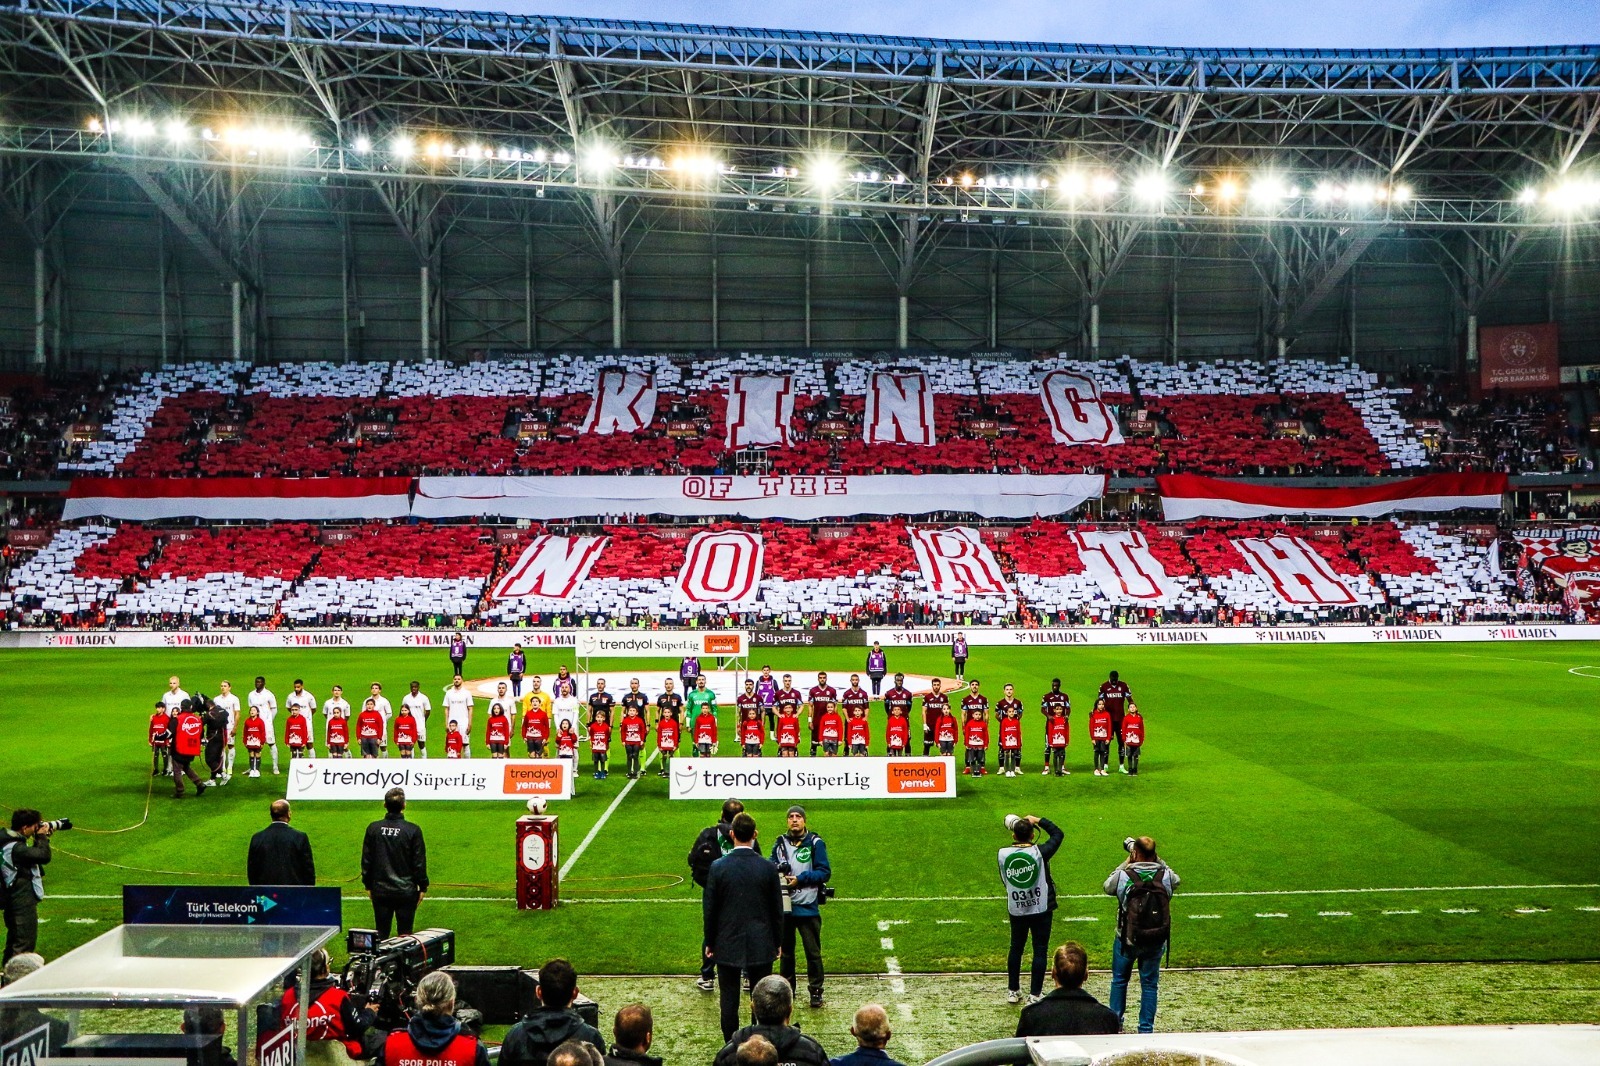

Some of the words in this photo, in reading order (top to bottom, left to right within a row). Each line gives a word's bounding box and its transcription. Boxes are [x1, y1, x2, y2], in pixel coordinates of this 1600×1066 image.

[1506, 367, 1536, 376] GENÇLİK
[1510, 373, 1550, 382] BAKANLIĞI
[683, 476, 732, 498] OF
[759, 476, 847, 496] THE
[1518, 602, 1561, 612] SAMSUN
[758, 632, 814, 644] SüperLig
[1028, 632, 1088, 642] YILMADEN
[1149, 632, 1208, 642] YILMADEN
[1268, 630, 1326, 640] YILMADEN
[1385, 630, 1442, 640] YILMADEN
[1500, 628, 1557, 638] YILMADEN
[58, 635, 116, 645] YILMADEN
[176, 635, 235, 645] YILMADEN
[294, 634, 354, 644] YILMADEN
[708, 637, 737, 646] trendyol
[600, 639, 652, 651] trendyol
[654, 640, 699, 652] SüperLig
[712, 644, 734, 652] yemek
[762, 692, 770, 700] 7
[510, 769, 558, 780] trendyol
[893, 766, 941, 778] trendyol
[323, 769, 409, 788] trendyol
[414, 772, 486, 790] SüperLig
[702, 770, 791, 790] trendyol
[796, 772, 870, 790] SüperLig
[900, 778, 936, 790] yemek
[516, 780, 552, 790] yemek
[380, 826, 400, 836] TFF
[1006, 864, 1036, 878] Bilyoner
[1012, 887, 1042, 902] 0316
[186, 902, 210, 912] Türk
[212, 902, 258, 912] Telekom
[265, 1040, 290, 1066] VAR
